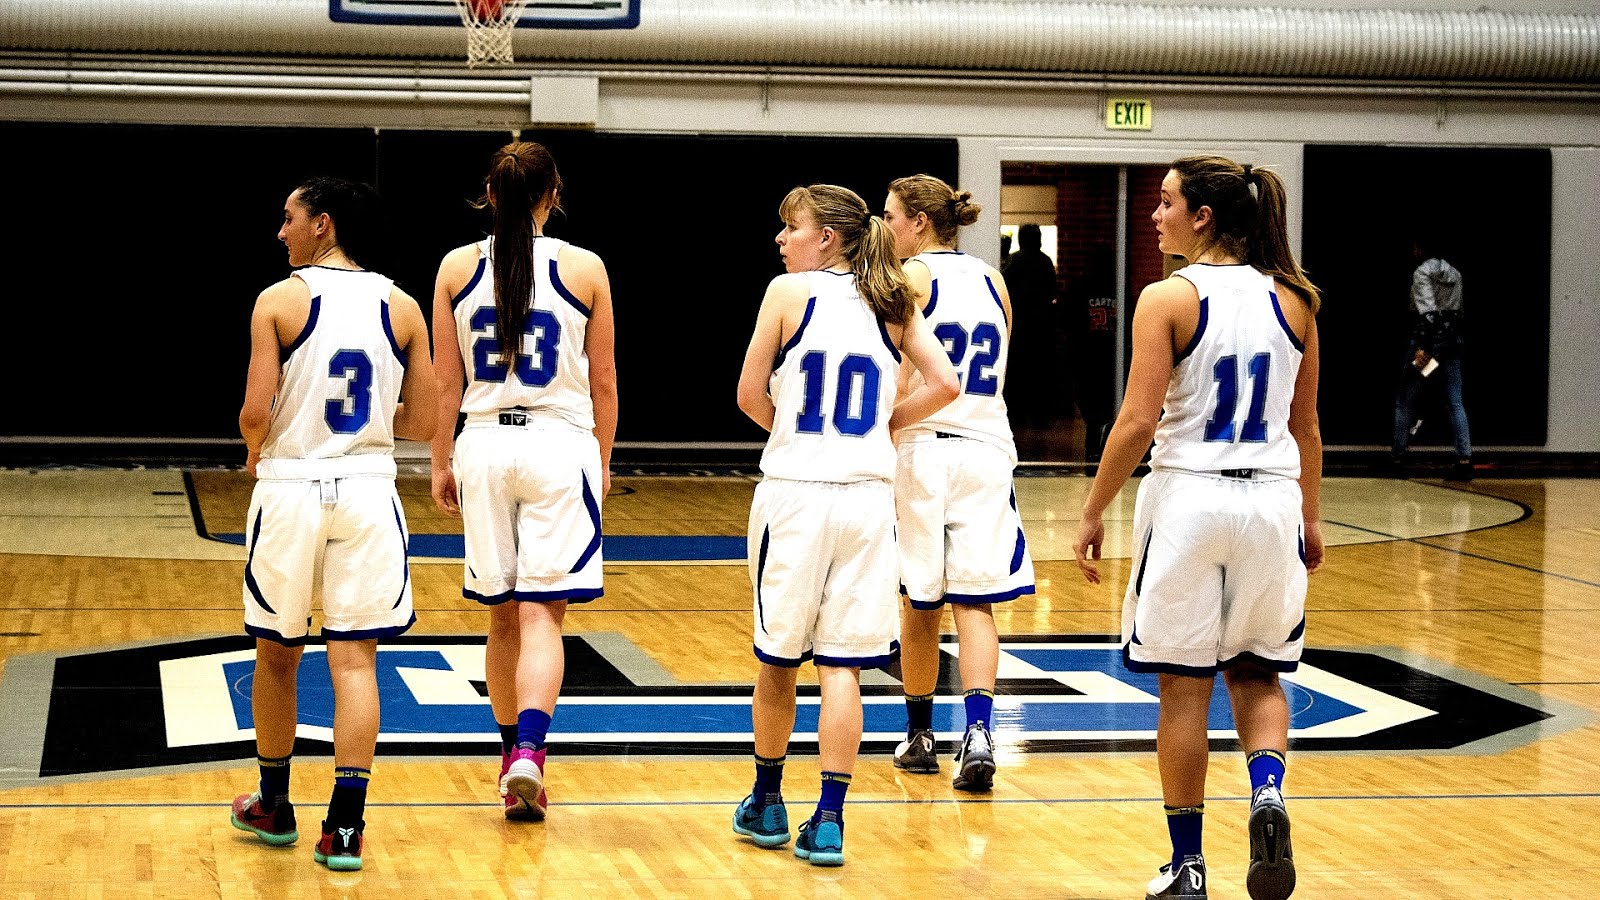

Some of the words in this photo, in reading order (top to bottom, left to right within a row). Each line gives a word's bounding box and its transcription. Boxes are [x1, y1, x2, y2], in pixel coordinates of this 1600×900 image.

[1114, 102, 1146, 125] EXIT
[470, 306, 561, 388] 23
[933, 322, 1002, 397] 22
[324, 348, 374, 435] 3
[795, 350, 882, 438] 10
[1203, 352, 1271, 443] 11
